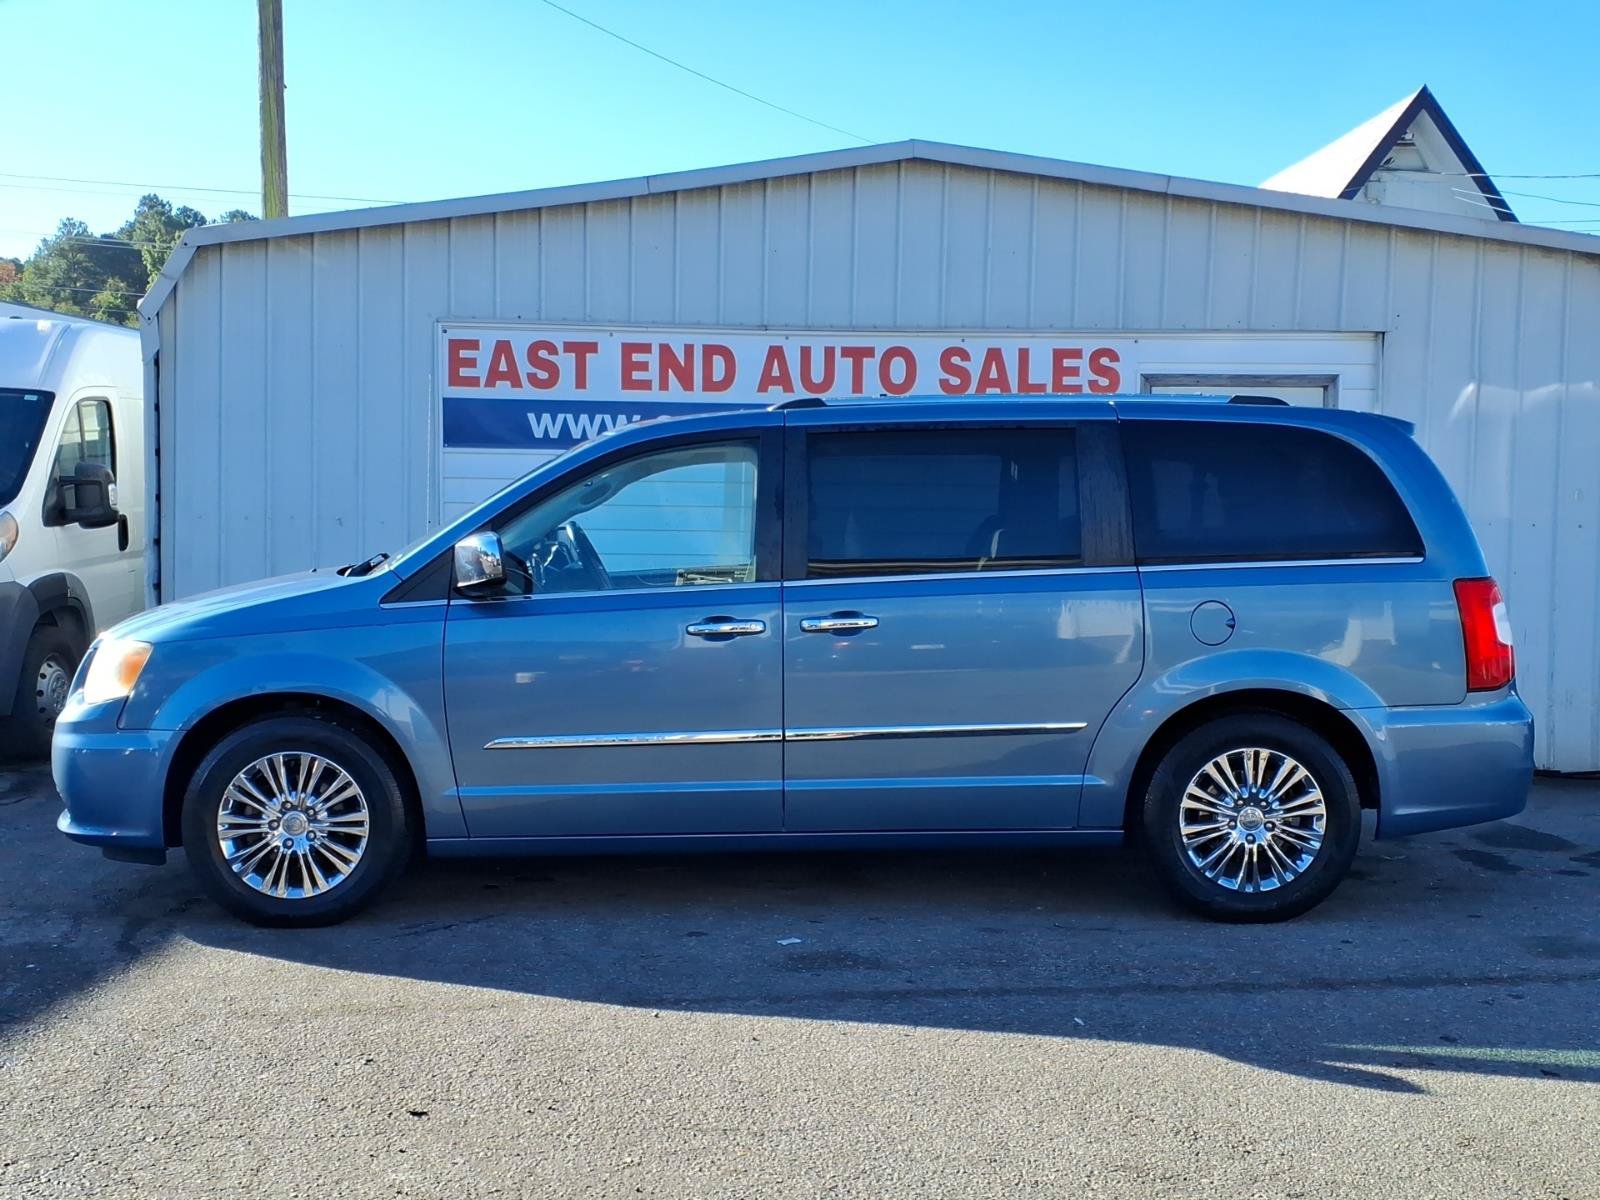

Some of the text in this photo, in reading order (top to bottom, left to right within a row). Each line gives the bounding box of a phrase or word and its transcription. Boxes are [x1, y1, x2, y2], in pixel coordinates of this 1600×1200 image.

[448, 338, 1122, 395] EAST END AUTO SALES
